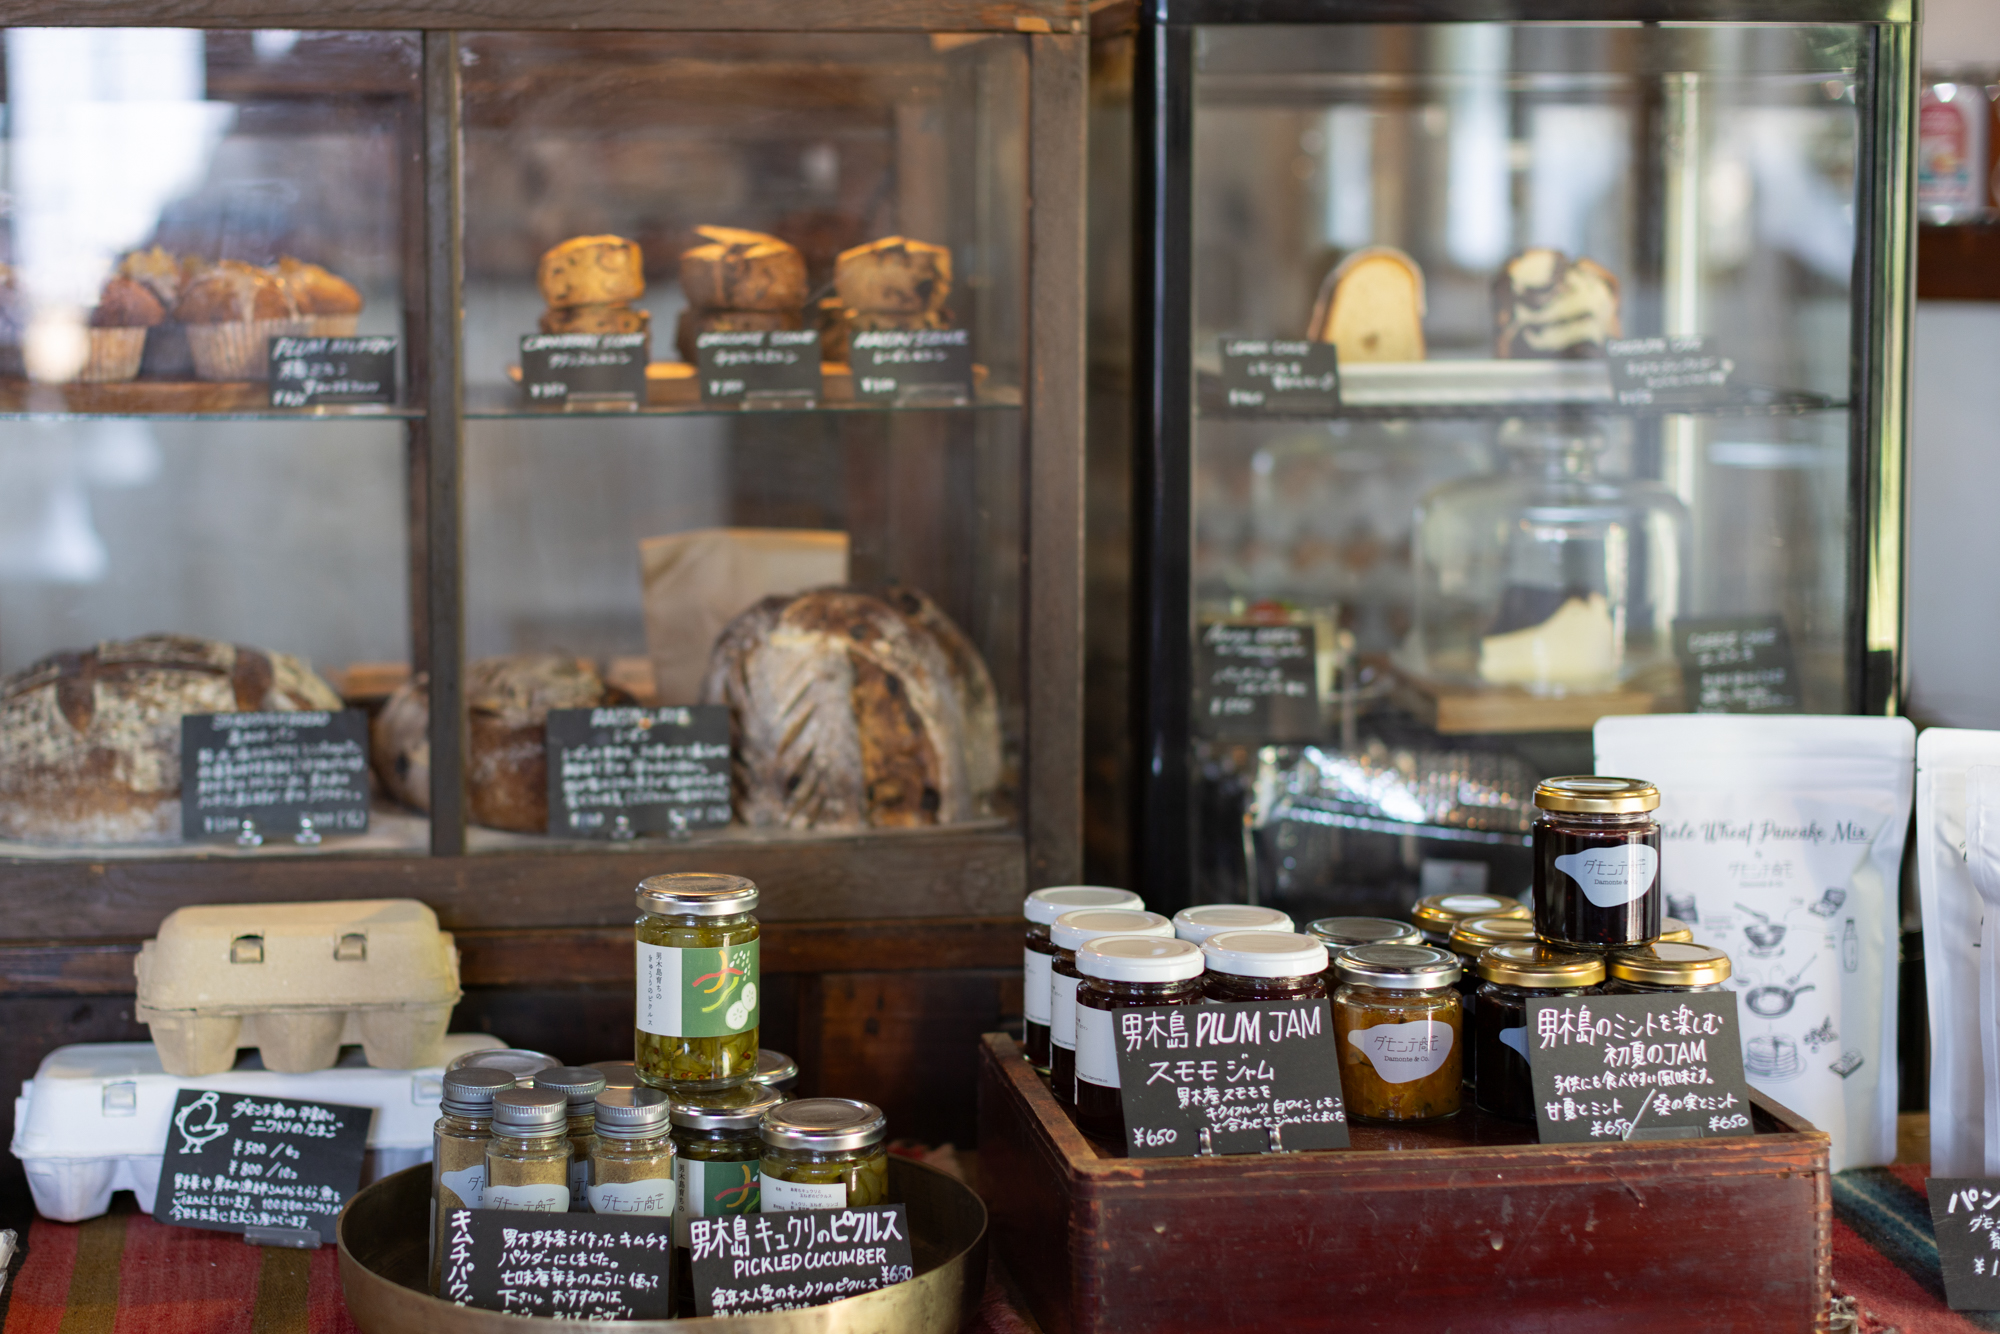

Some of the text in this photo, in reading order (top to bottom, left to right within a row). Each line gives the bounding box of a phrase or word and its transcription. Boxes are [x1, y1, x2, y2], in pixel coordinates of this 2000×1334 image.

[1661, 818, 1869, 846] hole Wheat Pancake Mix
[1583, 858, 1646, 876] ダモンテ店
[655, 951, 663, 1000] 男木島育ちの
[1121, 1006, 1321, 1052] 男木島 PLUM JAM
[1537, 1004, 1724, 1049] 男木島のミントを楽しむ
[1603, 1039, 1708, 1069] 初夏のJAM
[1553, 1066, 1715, 1096] 子供にも食べやすい風味です。
[1544, 1097, 1623, 1121] 甘夏とミント
[1652, 1092, 1739, 1116] 桑の実とミント
[1590, 1118, 1632, 1138] ¥650
[1708, 1113, 1750, 1132] ¥650
[1133, 1127, 1178, 1147] ¥650
[690, 1210, 903, 1262] 男木島キュウリのピクルス
[497, 1249, 619, 1270] パウダーにしました。
[734, 1247, 887, 1279] PICKLED CUCUMBER
[1973, 1258, 2000, 1276] ¥1
[711, 1276, 879, 1308] 毎年大人気のキュウリのピクルス
